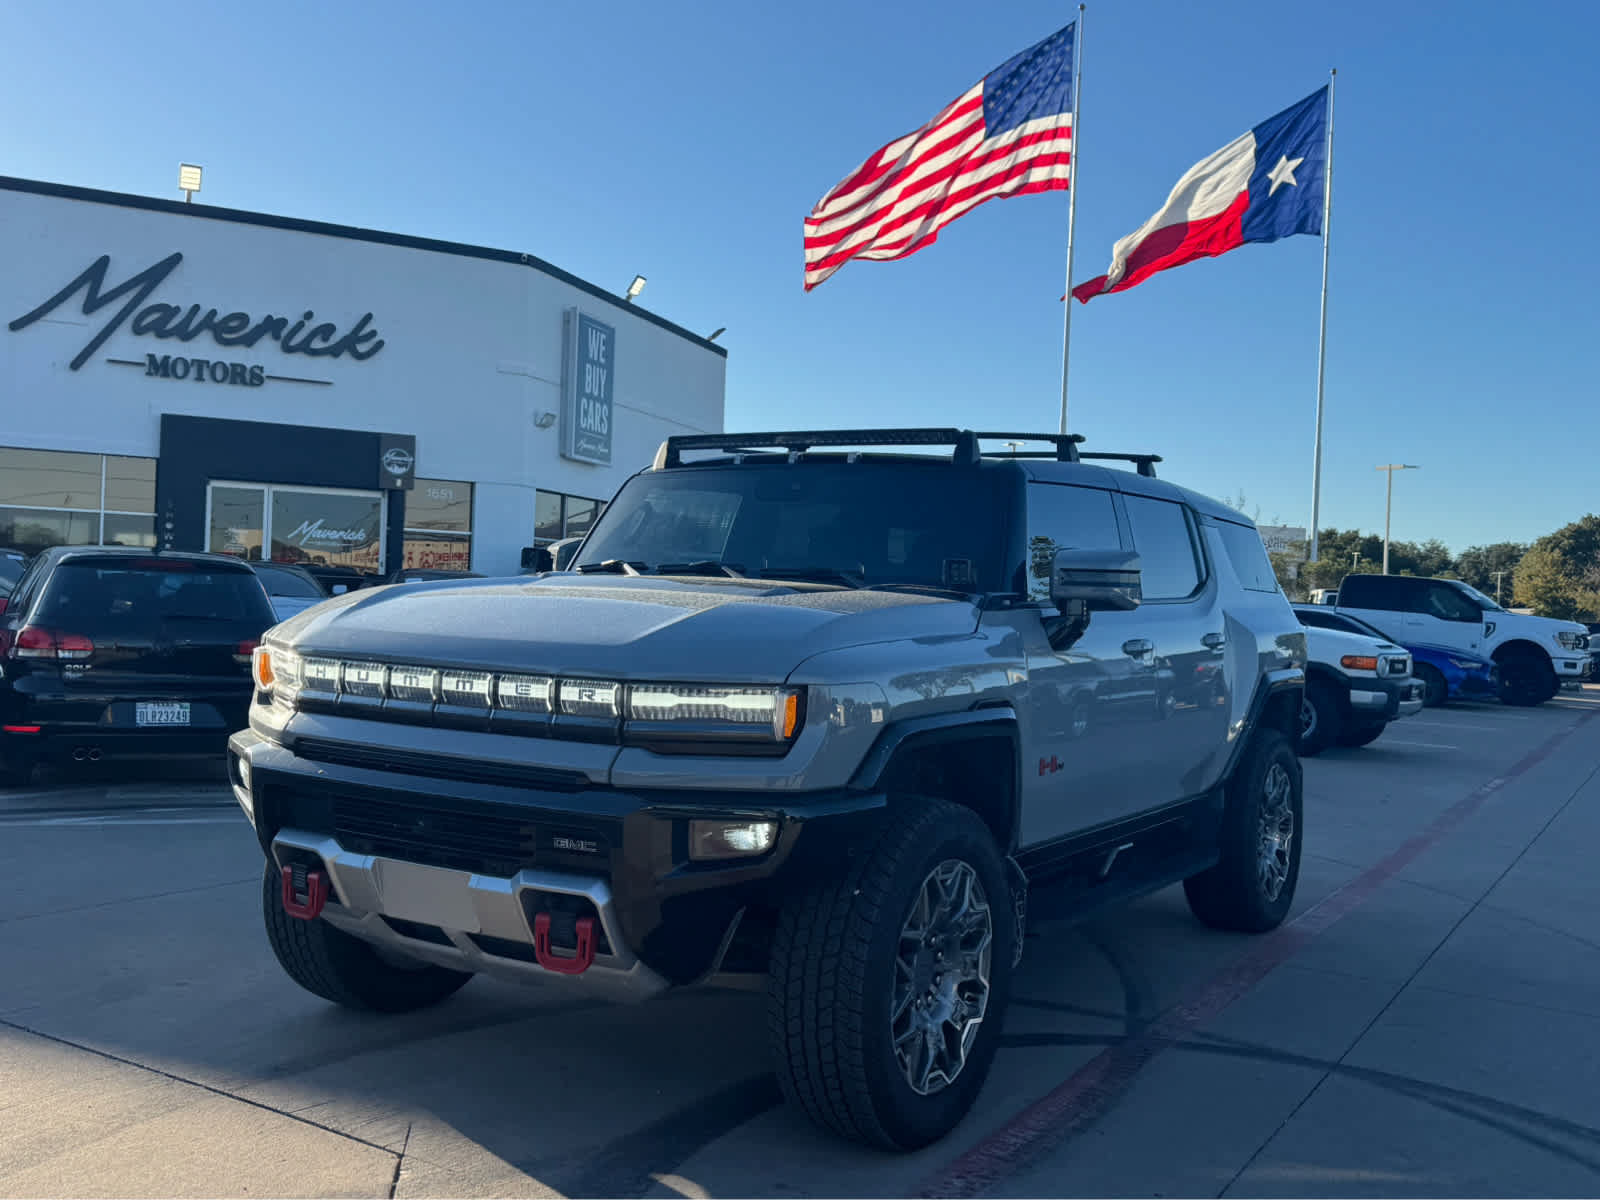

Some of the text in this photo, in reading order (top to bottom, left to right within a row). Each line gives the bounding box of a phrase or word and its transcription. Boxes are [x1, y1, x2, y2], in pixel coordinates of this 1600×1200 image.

[8, 251, 385, 371] Maverick
[588, 327, 607, 364] WE
[145, 352, 265, 387] MOTORS
[584, 363, 608, 398] BUY
[579, 398, 609, 435] CARS
[287, 518, 367, 546] Maverick
